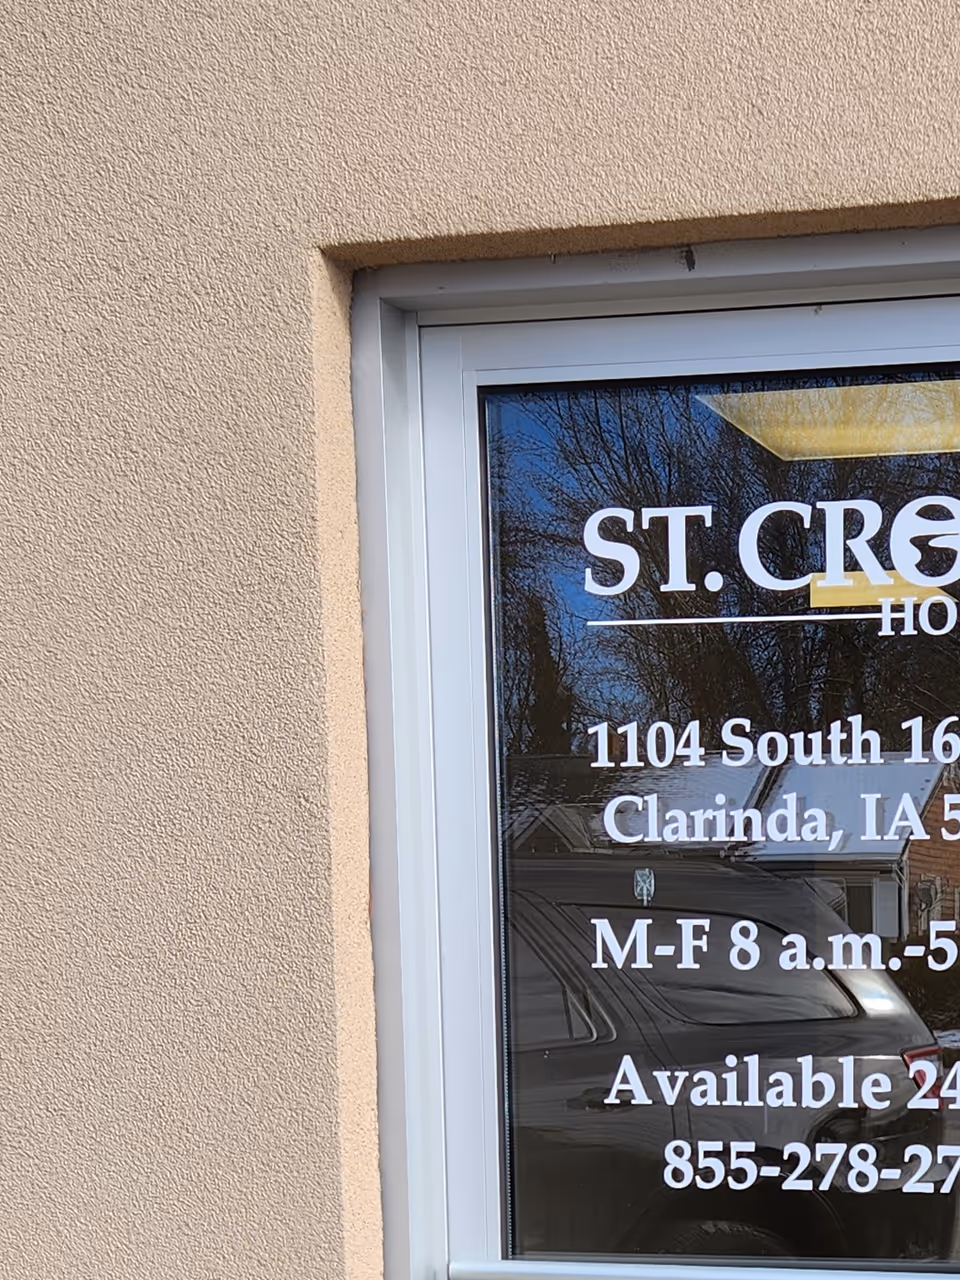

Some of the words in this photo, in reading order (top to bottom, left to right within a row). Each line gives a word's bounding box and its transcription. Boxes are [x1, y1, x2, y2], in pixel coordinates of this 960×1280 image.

[583, 505, 724, 596] ST.
[587, 719, 706, 768] 1104
[721, 713, 885, 767] South
[603, 791, 844, 852] Clarinda,
[859, 792, 931, 841] IA
[590, 918, 711, 970] M-F
[729, 919, 761, 971] 8
[778, 920, 958, 971] a.m.-5
[603, 1054, 893, 1110] Available
